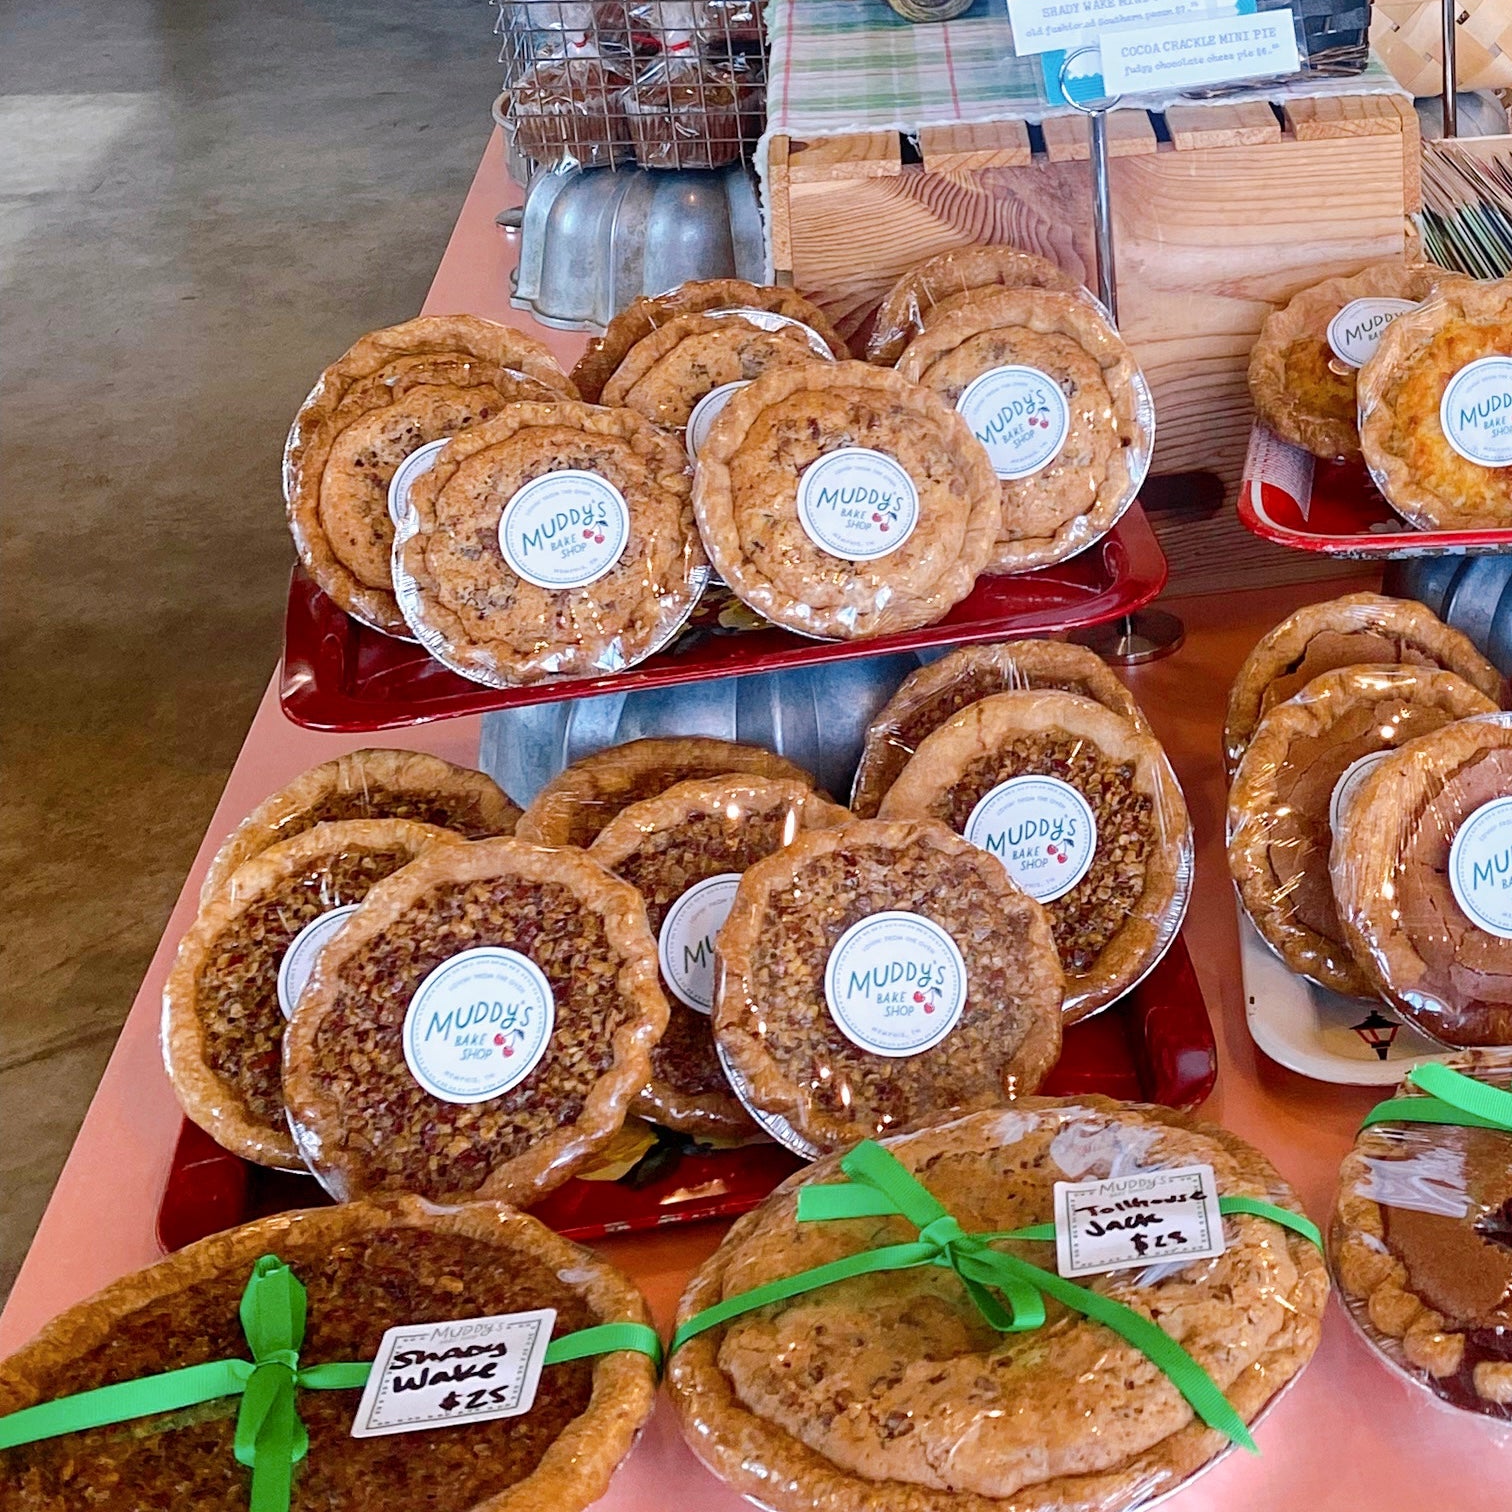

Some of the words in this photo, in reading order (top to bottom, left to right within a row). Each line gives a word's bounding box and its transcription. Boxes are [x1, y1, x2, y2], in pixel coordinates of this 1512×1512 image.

[1042, 3, 1080, 18] SHADY
[1121, 43, 1161, 58] COCOA
[1163, 35, 1217, 52] CRACKLE
[1219, 31, 1250, 45] MINI
[1253, 27, 1277, 39] PIE
[1345, 311, 1403, 345] MUDD
[975, 389, 1046, 445] MUDDY'S
[1483, 416, 1506, 430] BAKE
[1002, 424, 1026, 444] BAKE
[1012, 430, 1036, 449] SHOP
[816, 486, 903, 511] MUDDY'S
[840, 508, 867, 520] BAKE
[522, 499, 607, 556] MUDDY'S
[845, 519, 872, 530] SHOP
[550, 533, 577, 552] BAKE
[561, 543, 587, 559] SHOP
[986, 814, 1077, 857] MUDDY'S
[1012, 846, 1040, 860] BAKE
[1020, 858, 1049, 871] SHOP
[847, 959, 947, 1000] MUDDY'S
[876, 991, 907, 1004] BAKE
[424, 999, 534, 1042] MUDDY'S
[883, 1005, 915, 1018] SHOP
[454, 1033, 488, 1047] BAKE
[460, 1048, 493, 1061] SHOP
[1099, 1174, 1167, 1196] MUDDY'S
[430, 1321, 504, 1343] MUDDY'S
[438, 1385, 510, 1411] $25
